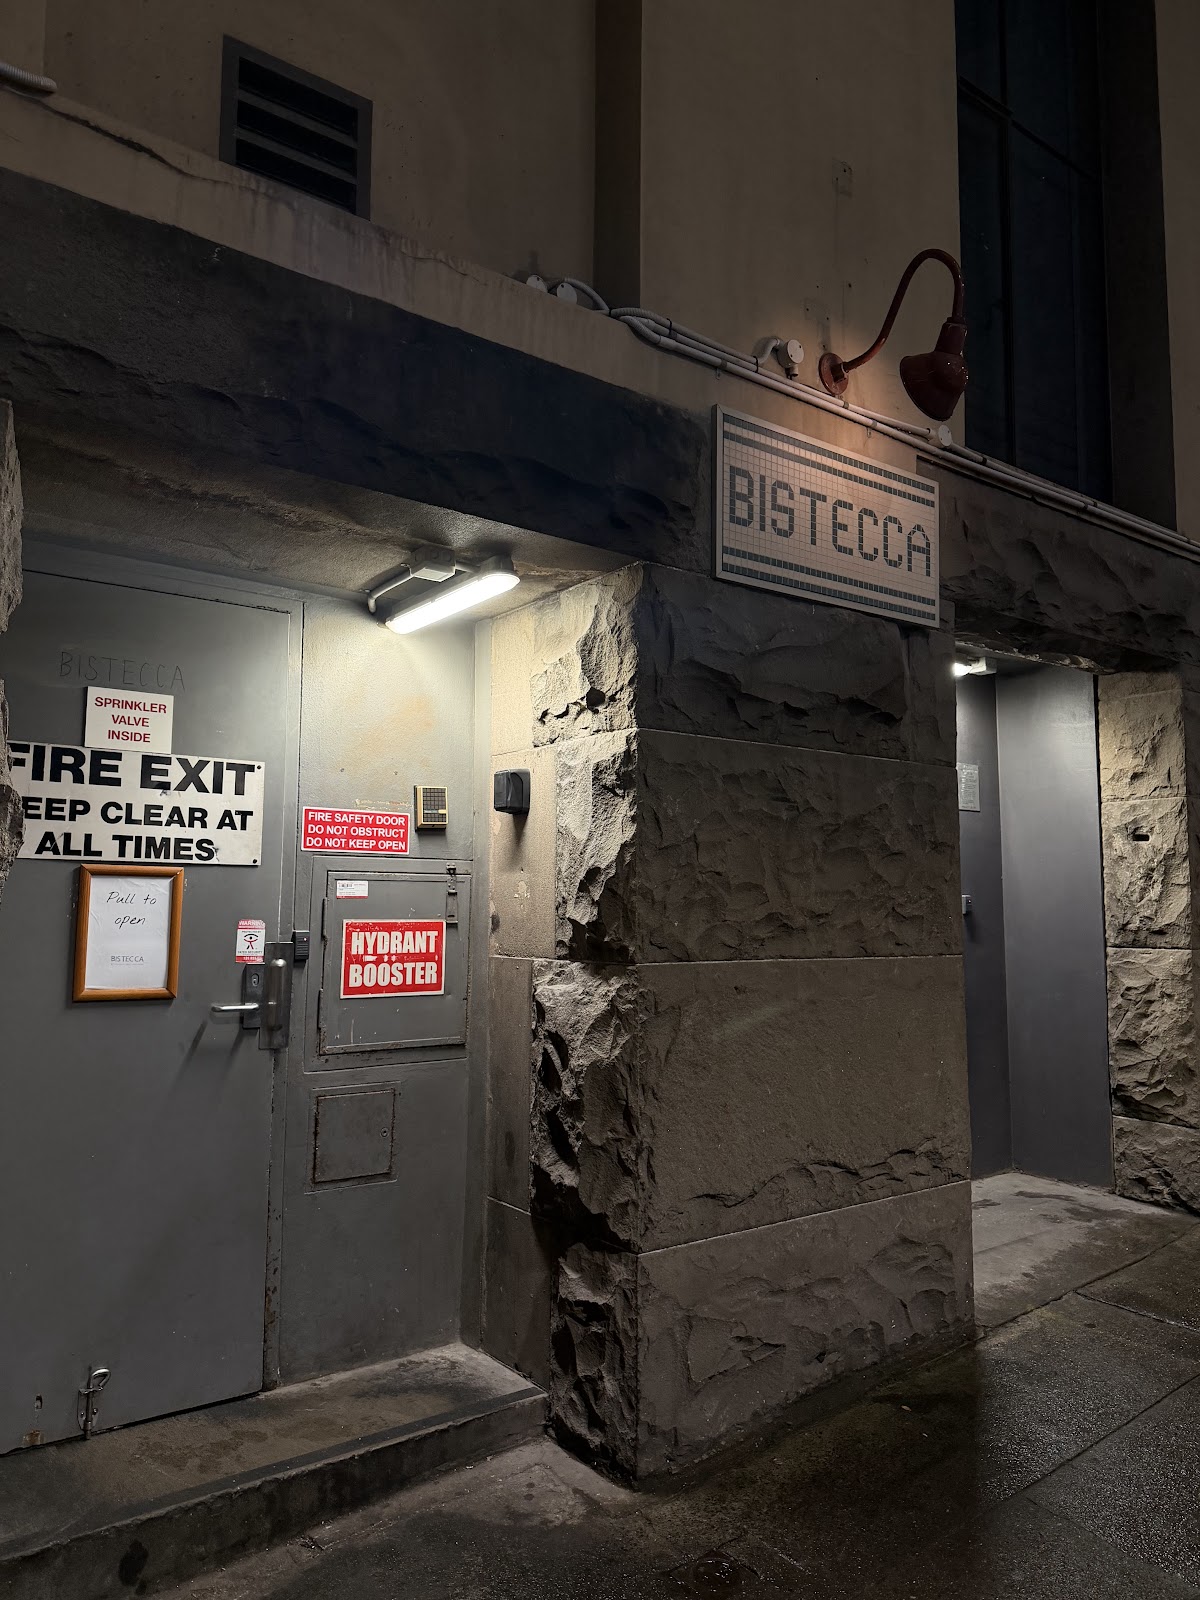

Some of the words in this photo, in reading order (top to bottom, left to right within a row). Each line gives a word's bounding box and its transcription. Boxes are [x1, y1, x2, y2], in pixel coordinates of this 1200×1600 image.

[729, 465, 931, 577] BISTECCA
[59, 651, 186, 691] BISTECCA
[94, 696, 167, 714] SPRINKLER
[111, 714, 150, 728] VALVE
[107, 730, 151, 743] INSIDE
[140, 754, 256, 796] EXIT
[21, 796, 91, 822] EEP
[100, 801, 208, 829] CLEAR
[216, 809, 254, 831] AT
[308, 811, 332, 822] FIRE
[334, 813, 374, 824] SAFETY
[375, 815, 406, 826] DOOR
[307, 824, 325, 834] DO
[326, 825, 349, 836] NOT
[350, 826, 406, 838] OBSTRUCT
[35, 831, 103, 857] ALL
[111, 834, 216, 861] TIMES
[306, 836, 323, 847] DO
[324, 837, 347, 848] NOT
[349, 838, 376, 849] KEEP
[378, 840, 406, 850] OPEN
[106, 891, 136, 905] Pull
[143, 893, 157, 905] to
[114, 915, 146, 930] open
[351, 930, 439, 955] HYDRANT
[348, 961, 438, 988] BOOSTER
